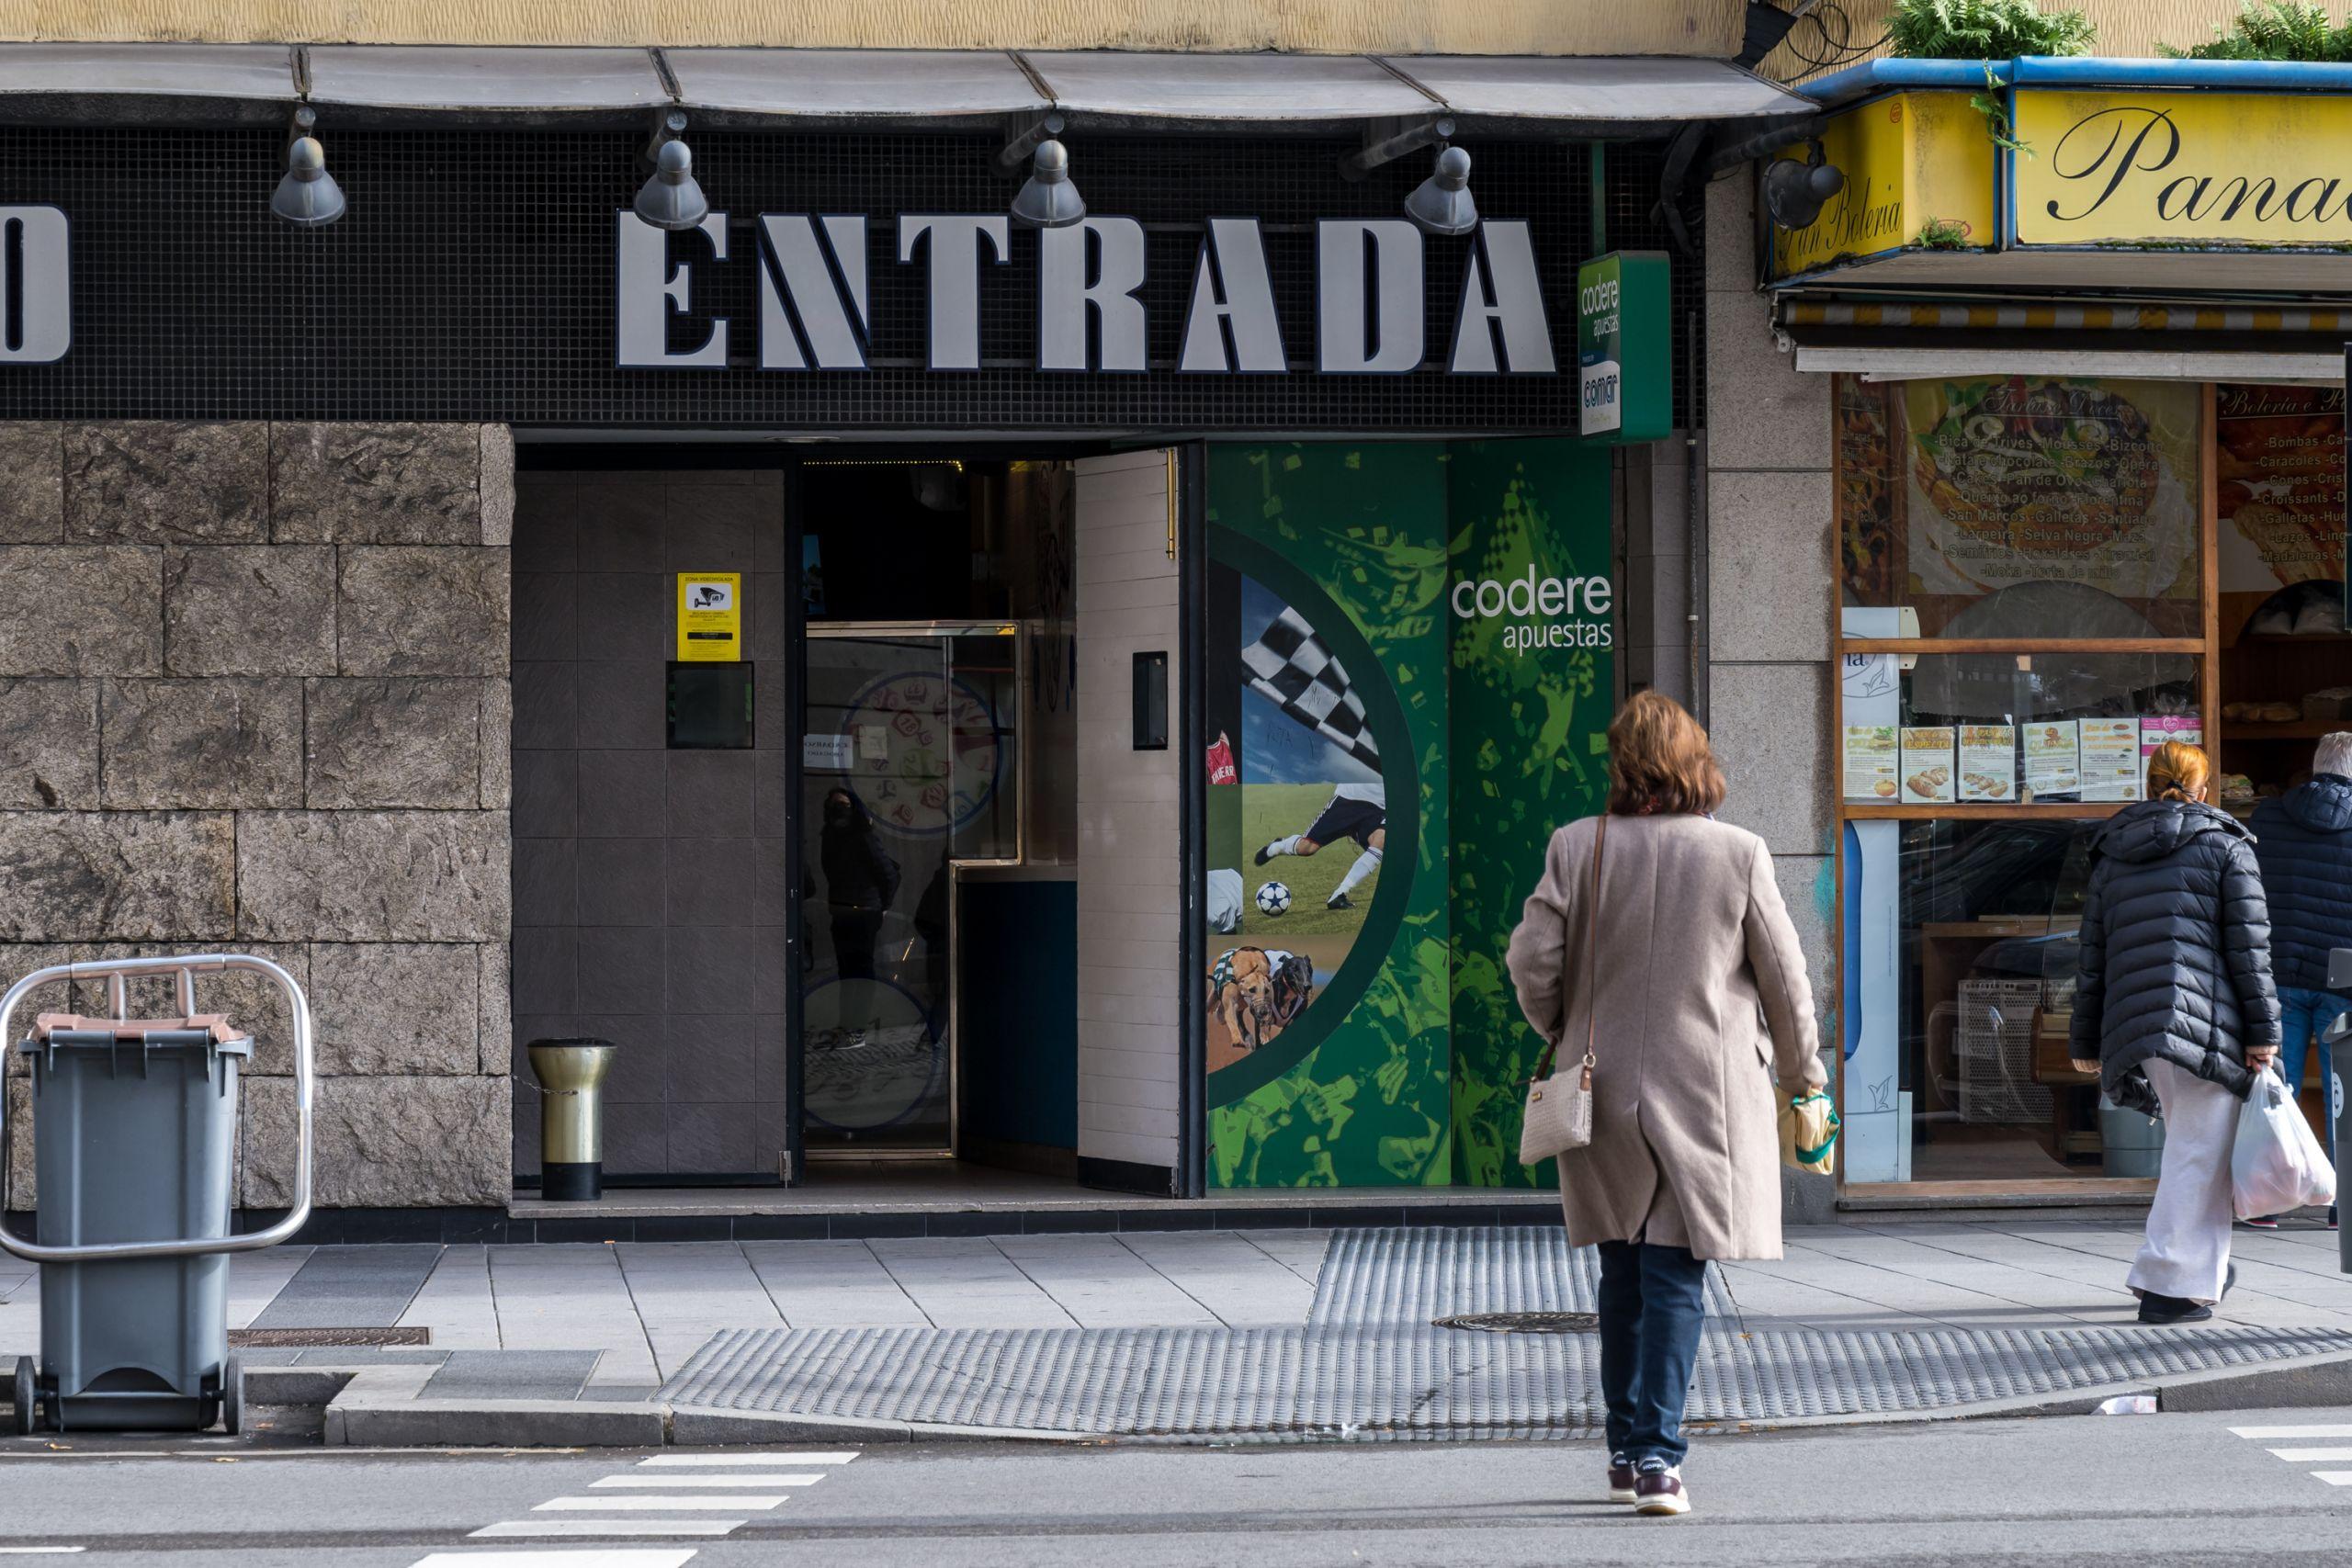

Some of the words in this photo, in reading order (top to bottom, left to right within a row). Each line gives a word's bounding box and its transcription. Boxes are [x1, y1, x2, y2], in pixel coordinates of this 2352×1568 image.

[2047, 107, 2352, 222] Pana
[616, 208, 1559, 374] ENTRADA
[1582, 273, 1618, 316] codere
[1593, 314, 1619, 343] apuestas
[1585, 375, 1617, 408] comar
[1992, 434, 2032, 449] Trives
[2038, 436, 2102, 451] -Mousses
[2264, 436, 2319, 448] -Bombas
[1990, 455, 2056, 468] chocolate
[2061, 456, 2110, 468] -Brazos
[2256, 456, 2322, 468] -Caracoles
[1952, 471, 1997, 484] -Cakes
[2002, 474, 2031, 486] -Pan
[2036, 475, 2052, 485] de
[2056, 475, 2083, 487] Ovo
[2264, 475, 2309, 486] -Conos
[2012, 493, 2028, 503] ao
[2032, 491, 2067, 504] forno
[2258, 491, 2328, 504] -Croissants
[1942, 508, 1973, 521] -San
[1978, 510, 2026, 522] Marcos
[2030, 511, 2089, 523] -Galletas
[2095, 513, 2157, 530] -Santiago
[2262, 511, 2315, 524] -Galletas
[2020, 528, 2060, 540] -Selva
[2065, 529, 2102, 543] Negra
[2270, 532, 2312, 543] -Lazos
[2258, 549, 2328, 563] -Madalenas
[1980, 563, 2021, 578] -Moka
[2025, 564, 2065, 579] -Torta
[1452, 563, 1611, 618] codere
[1503, 618, 1612, 657] apuestas
